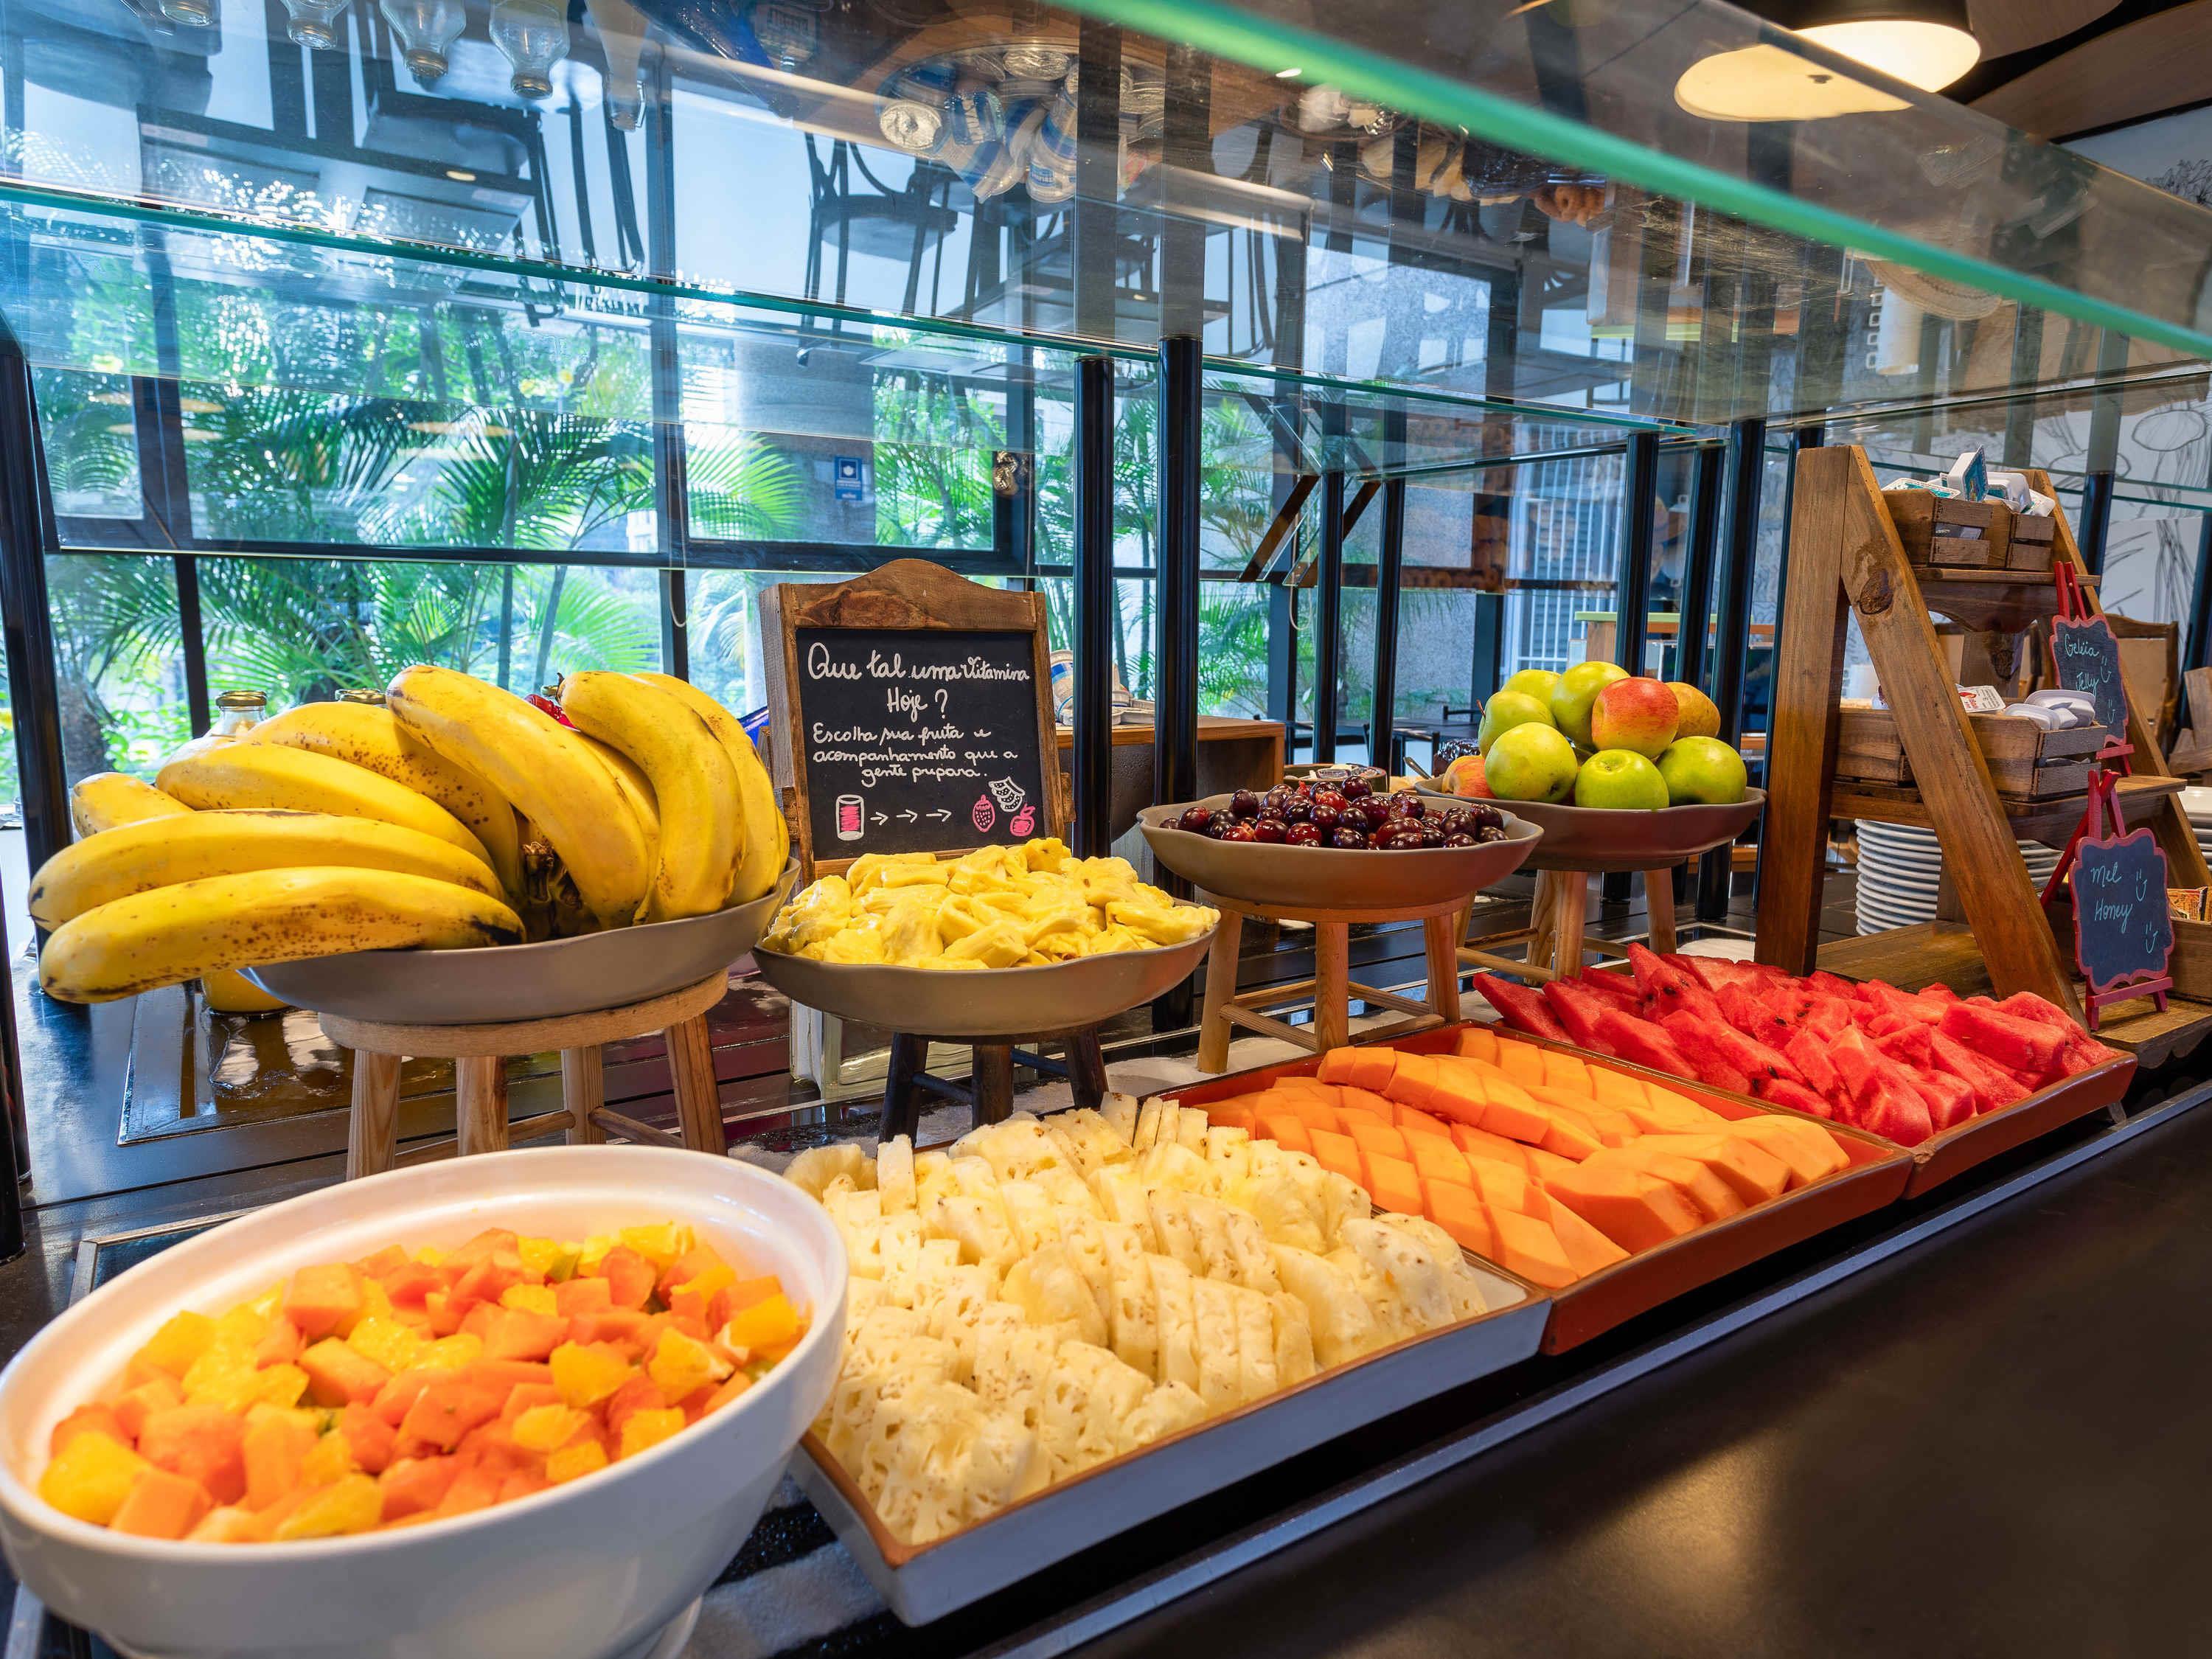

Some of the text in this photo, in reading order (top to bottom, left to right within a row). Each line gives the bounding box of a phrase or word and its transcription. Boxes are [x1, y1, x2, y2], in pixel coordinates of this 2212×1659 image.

[808, 642, 863, 680] Que
[866, 650, 906, 678] tal
[911, 665, 961, 681] uma
[2076, 672, 2099, 697] Jelly
[887, 686, 928, 723] Hoje
[813, 722, 992, 746] Escolha sua fruta e
[813, 745, 1018, 768] acompanhamento que a
[860, 764, 907, 788] gente
[2094, 897, 2133, 934] Honey
